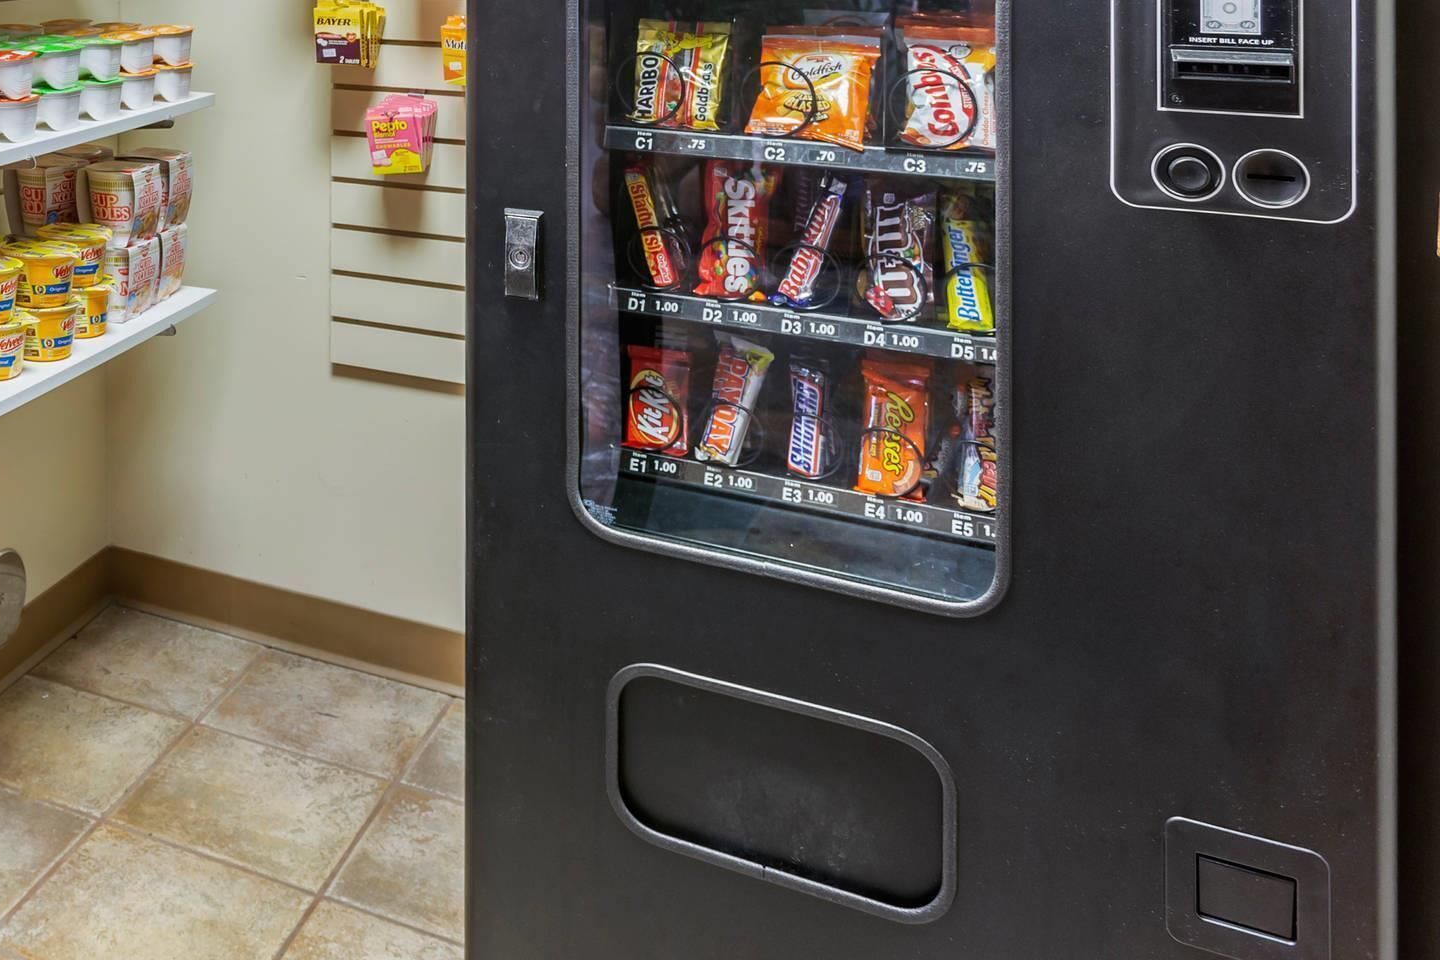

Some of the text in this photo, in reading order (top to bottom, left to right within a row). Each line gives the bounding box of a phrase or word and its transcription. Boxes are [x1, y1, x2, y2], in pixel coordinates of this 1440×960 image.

[316, 17, 352, 27] BAYER
[1189, 36, 1217, 44] INSERT
[1219, 37, 1236, 45] BILL
[791, 62, 842, 81] Goldfish
[636, 55, 659, 120] HARIBO
[371, 119, 408, 133] Pepto
[635, 138, 653, 150] C1
[764, 147, 785, 161] C2
[903, 158, 926, 173] C3
[725, 175, 756, 294] Skittles
[778, 246, 818, 302] Baby
[948, 224, 981, 322] Butterfinger
[628, 298, 646, 312] D1
[702, 308, 723, 323] D2
[781, 319, 802, 334] D3
[864, 330, 886, 346] D4
[951, 343, 974, 360] D5
[788, 377, 819, 472] SNICKERS
[881, 391, 916, 476] Reese's
[629, 458, 647, 473] E1
[703, 473, 724, 488] E2
[782, 487, 802, 503] E3
[864, 503, 886, 520] E4
[951, 519, 974, 537] E5
